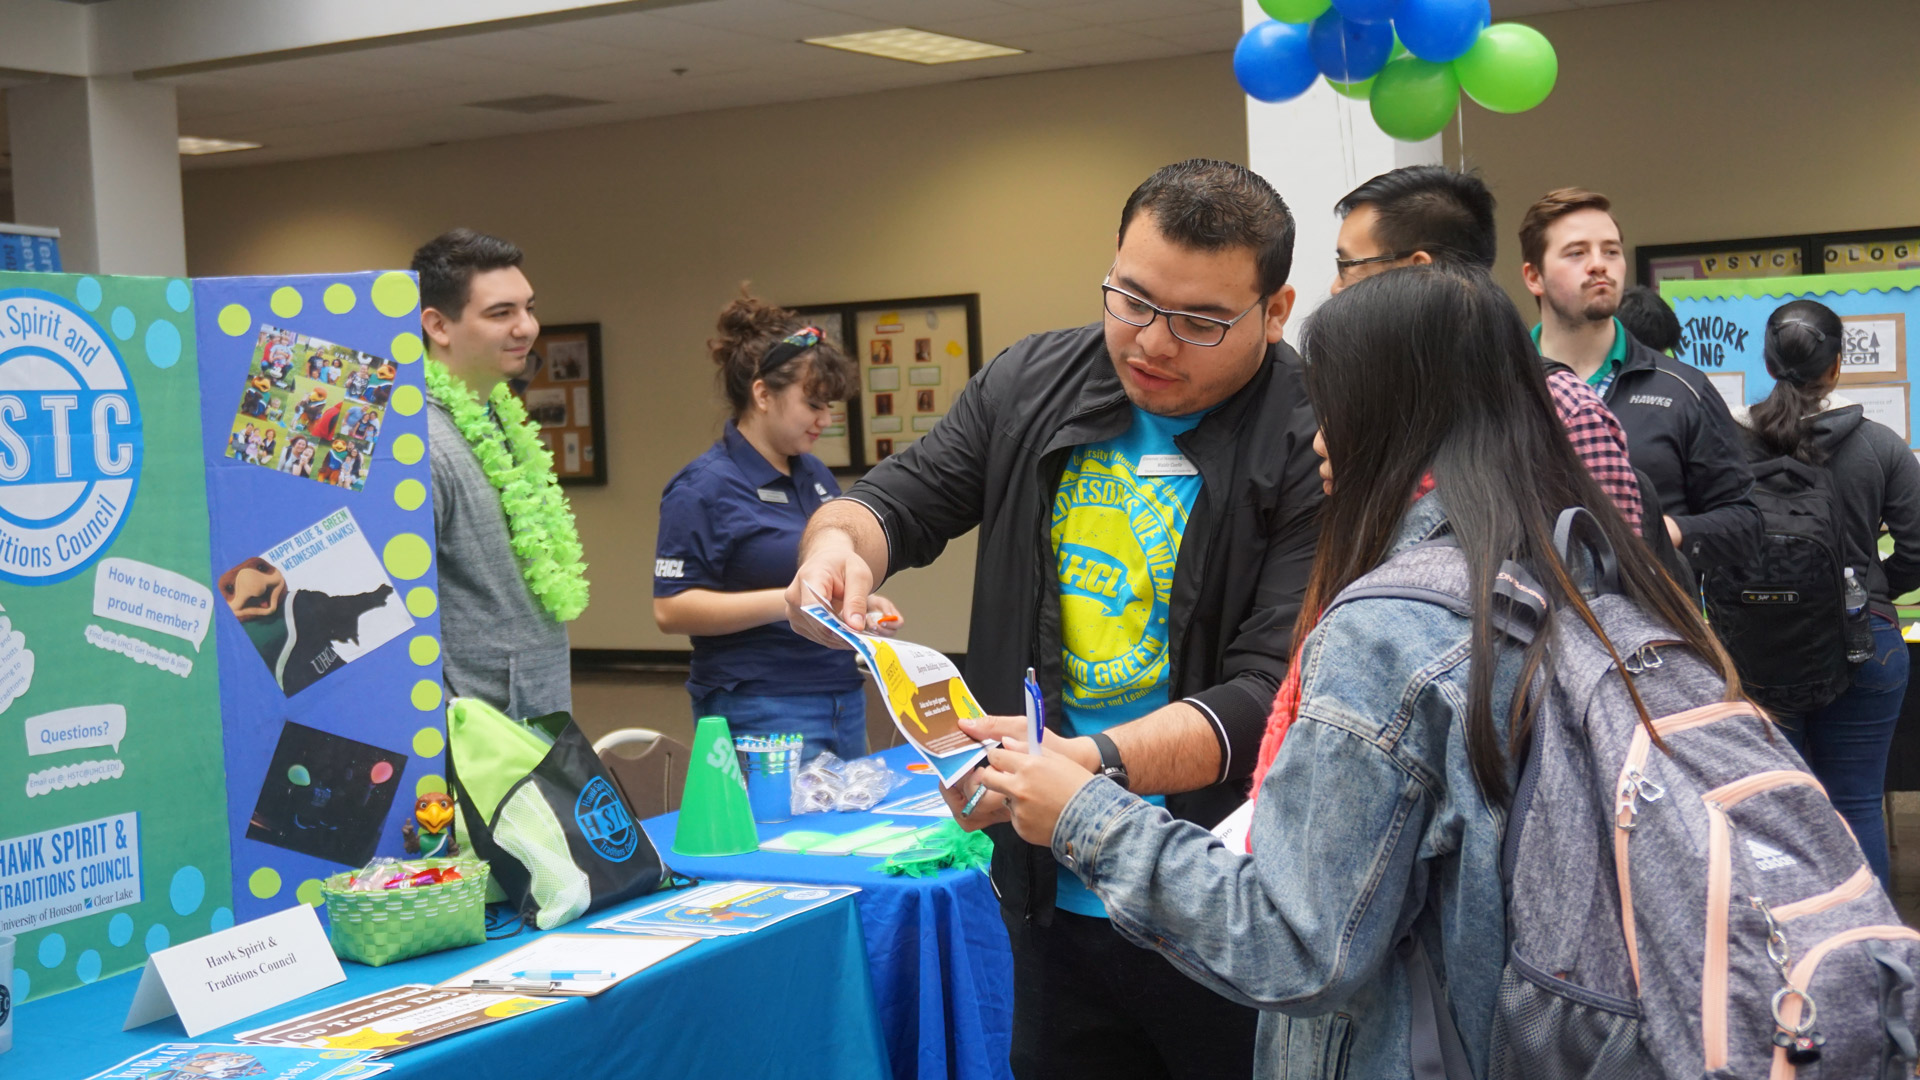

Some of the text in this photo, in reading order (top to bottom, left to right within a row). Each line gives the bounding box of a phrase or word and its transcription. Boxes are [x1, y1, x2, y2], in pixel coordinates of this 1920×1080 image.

[1705, 245, 1910, 273] PSYCHOLOG
[6, 305, 101, 367] Spirit and
[1692, 342, 1726, 368] ING
[1841, 353, 1876, 365] HCL
[1628, 394, 1673, 408] HAWKS
[56, 493, 118, 563] Council
[267, 509, 349, 563] HAPPY BLUE & GREEN
[1131, 508, 1162, 546] WE
[280, 522, 357, 572] WEDNESDAY, HAWKS!
[108, 565, 207, 609] How to become a
[107, 596, 200, 634] proud member?
[88, 629, 102, 641] Find
[102, 634, 111, 644] us
[110, 636, 117, 645] at
[1093, 634, 1164, 687] GREEN
[0, 676, 26, 703] raditions
[1107, 695, 1124, 707] and
[40, 720, 110, 745] Questions?
[29, 776, 48, 789] Email
[48, 774, 56, 785] us
[0, 818, 128, 878] HAWK SPIRIT &
[0, 855, 134, 911] TRADITIONS COUNCIL
[39, 910, 48, 922] of
[49, 901, 83, 919] Houston
[93, 894, 114, 908] Clear
[114, 888, 134, 902] Lake
[205, 936, 278, 969] Hawk Spirit &
[204, 952, 298, 993] Traditions Council
[287, 1028, 328, 1041] Go
[326, 1003, 412, 1028] Texan
